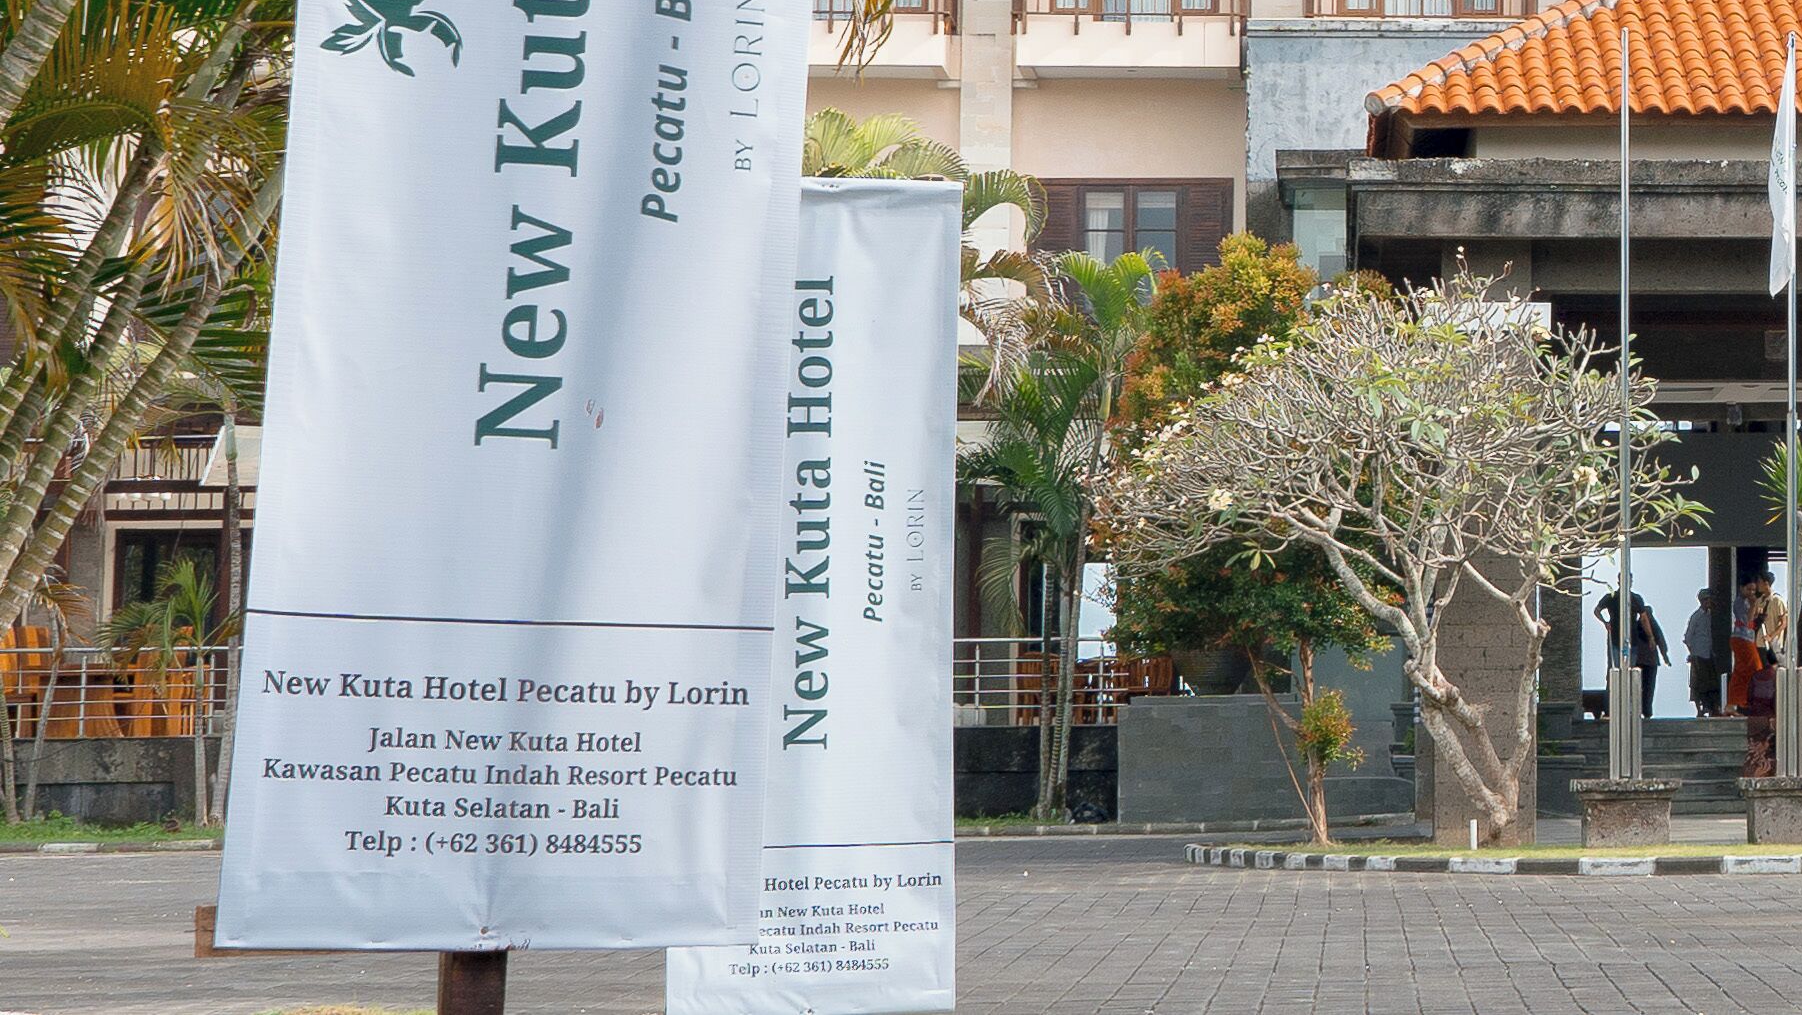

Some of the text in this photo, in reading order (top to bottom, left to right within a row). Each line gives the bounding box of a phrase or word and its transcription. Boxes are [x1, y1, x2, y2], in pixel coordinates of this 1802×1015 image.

[640, 63, 688, 223] Pecatu
[734, 139, 754, 171] BY
[474, 204, 573, 450] New
[863, 460, 885, 511] Bali
[782, 275, 834, 751] New Kuta Hotel
[906, 489, 925, 591] BY LORIN
[862, 534, 884, 623] Pecatu
[262, 669, 750, 711] New Kuta Hotel Pecatu by Lorin
[367, 727, 642, 753] Jalan New Kuta Hotel
[263, 758, 738, 787] Kawasan Pecatu Indah Resort Pecatu
[383, 795, 447, 817] Kuta
[453, 797, 551, 819] Selatan
[571, 797, 620, 819] Bali
[344, 829, 402, 858] Telp
[425, 831, 478, 856] (+62
[485, 833, 538, 857] 361)
[545, 833, 642, 854] 8484555
[764, 872, 942, 892] Hotel Pecatu by Lorin
[777, 906, 808, 918] New
[811, 905, 844, 917] Kuta
[848, 902, 885, 915] Hotel
[759, 921, 939, 937] ecatu Indah Resort Pecatu
[749, 943, 781, 955] Kuta
[785, 942, 837, 955] Selatan
[848, 939, 876, 952] Bali
[729, 962, 761, 978] Telp
[771, 962, 800, 975] (+62
[803, 960, 833, 973] 361)
[835, 958, 890, 971] 8484555
